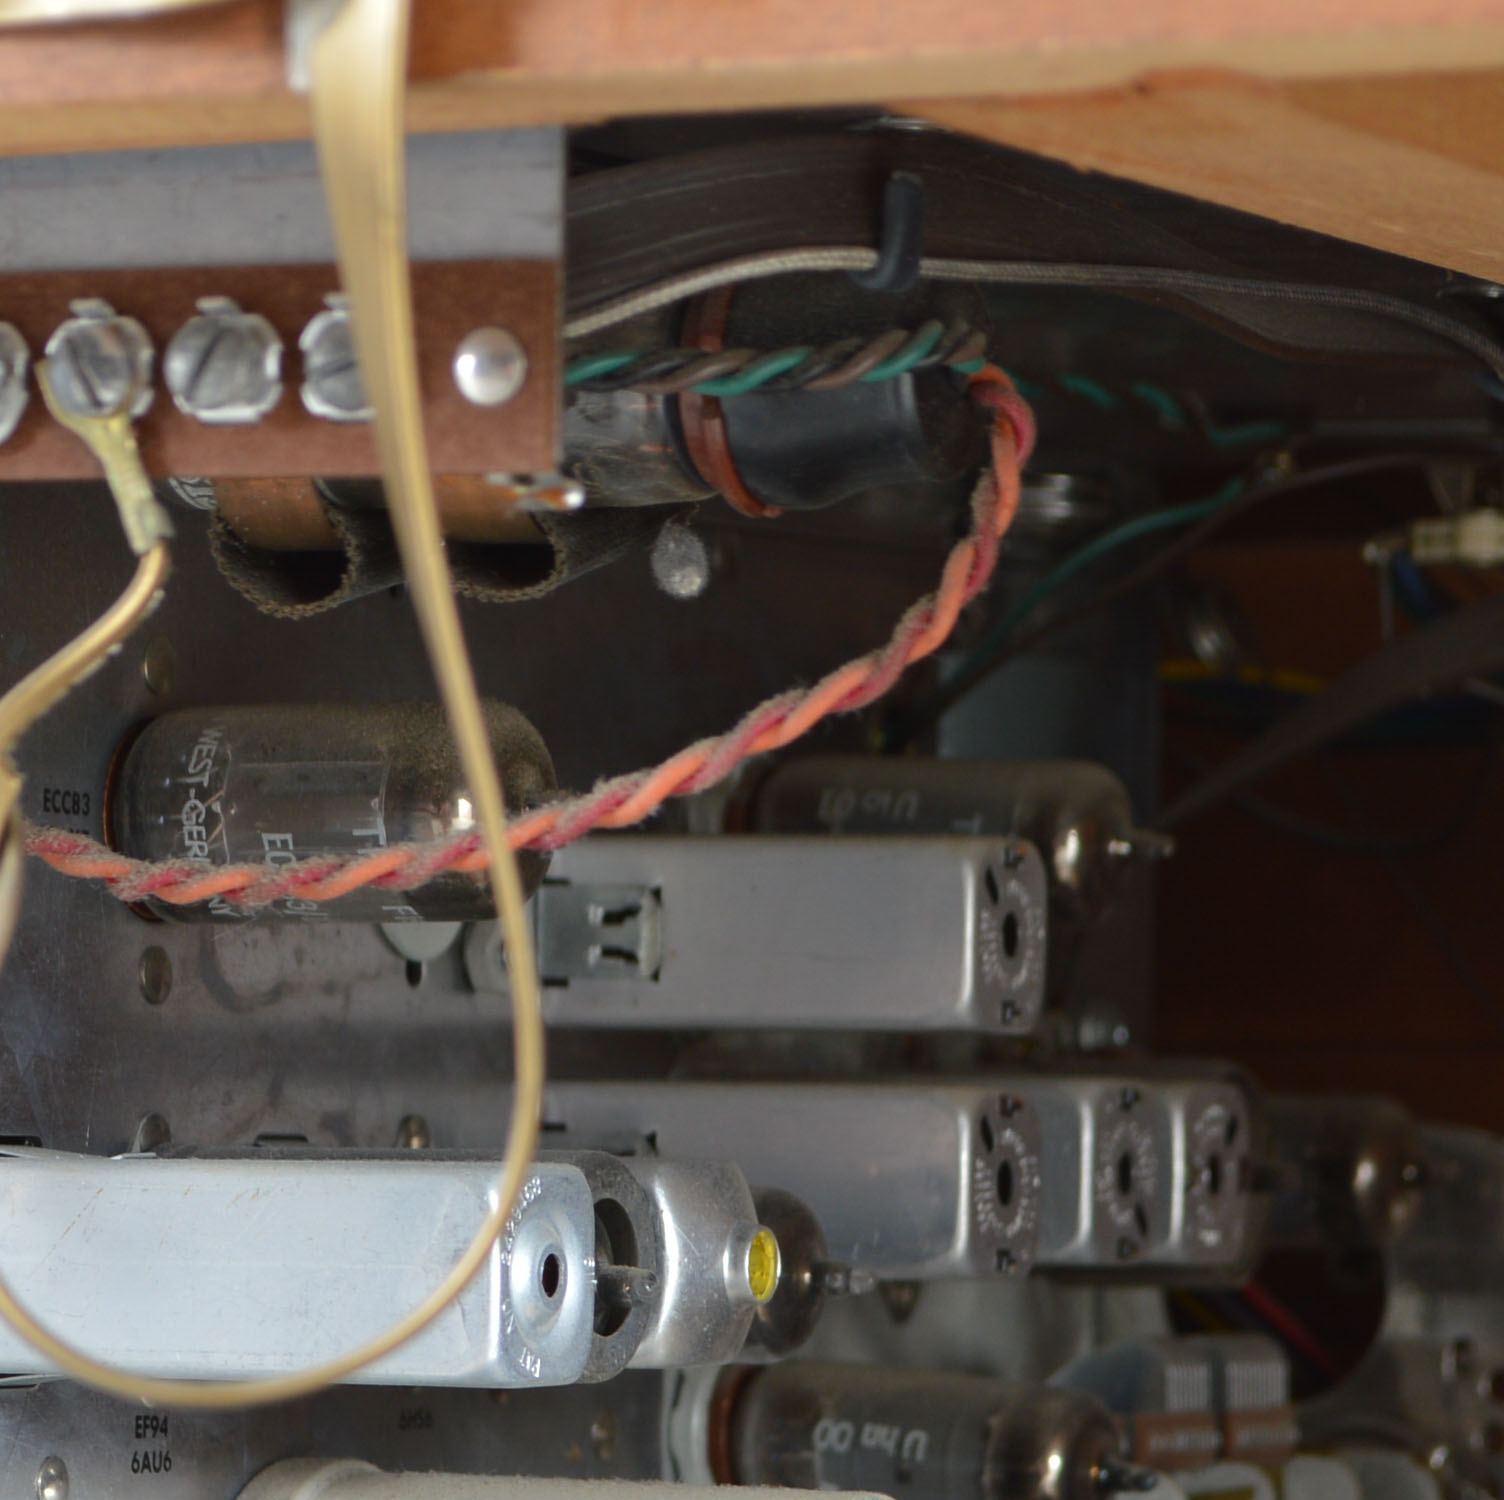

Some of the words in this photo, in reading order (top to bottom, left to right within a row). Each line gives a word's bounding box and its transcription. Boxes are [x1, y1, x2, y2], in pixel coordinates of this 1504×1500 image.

[42, 787, 91, 817] ECC83
[134, 1415, 169, 1441] EF94
[131, 1450, 173, 1475] 6AU6
